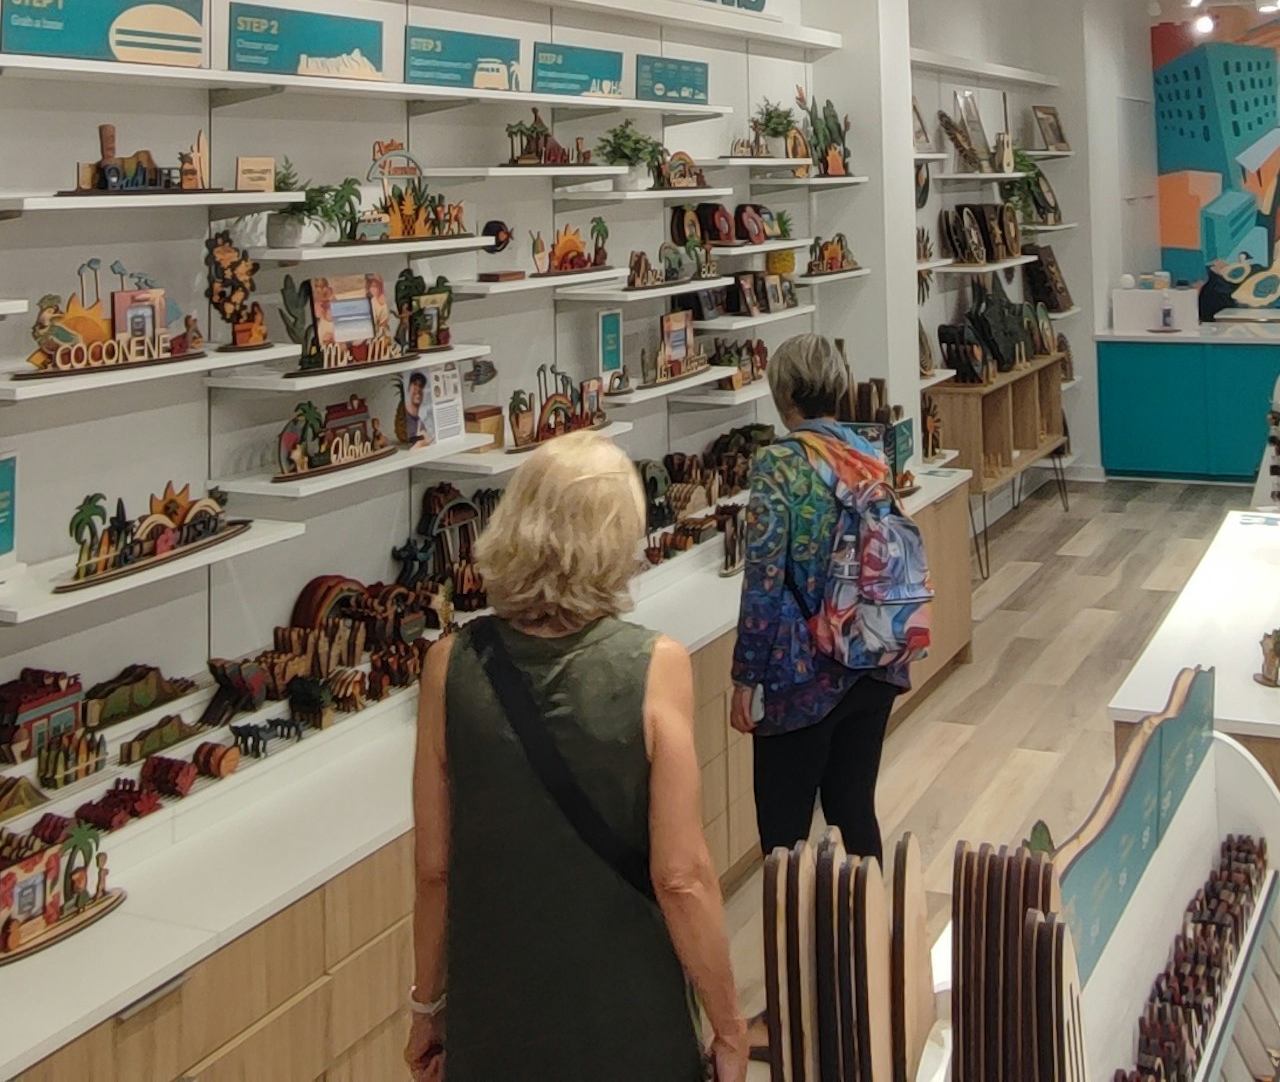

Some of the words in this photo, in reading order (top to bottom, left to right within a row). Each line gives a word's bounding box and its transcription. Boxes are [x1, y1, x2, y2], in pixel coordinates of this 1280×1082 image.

[236, 16, 268, 33] STEP
[270, 21, 279, 35] 2
[56, 333, 172, 370] COCONENE
[331, 430, 372, 464] Aloha
